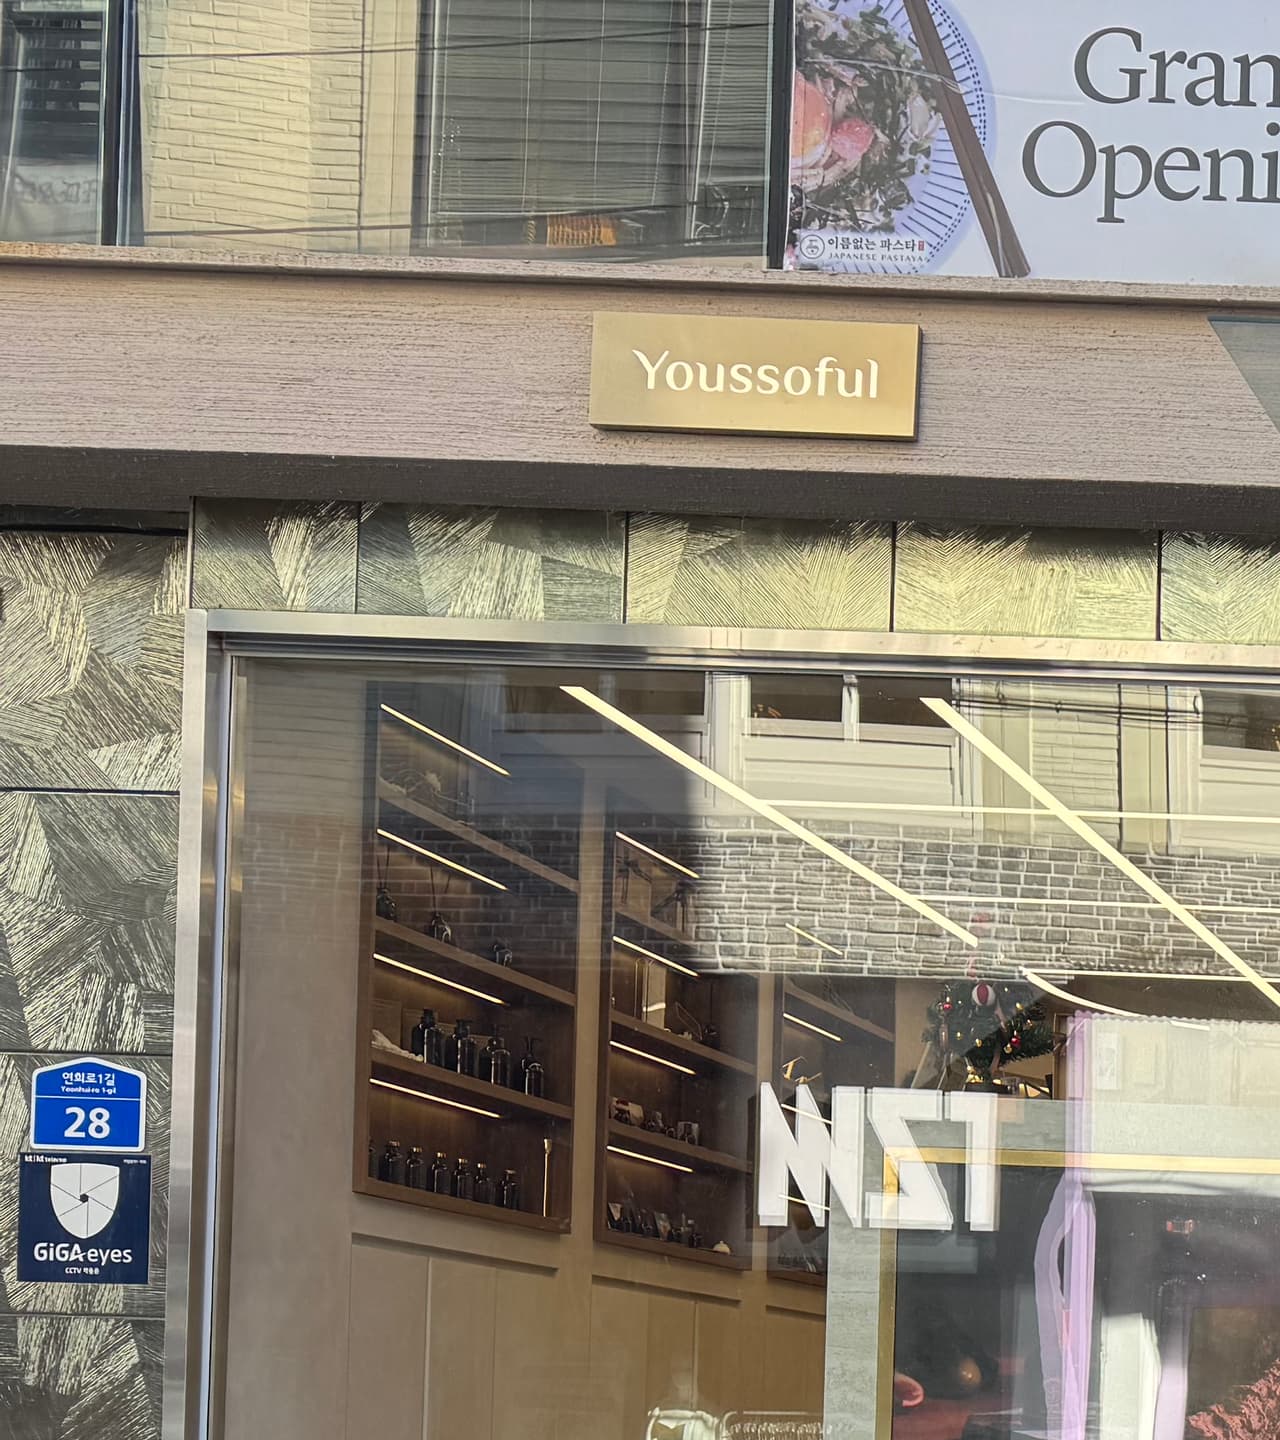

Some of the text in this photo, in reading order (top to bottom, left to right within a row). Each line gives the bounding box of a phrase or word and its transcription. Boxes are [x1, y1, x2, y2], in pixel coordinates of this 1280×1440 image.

[827, 236, 917, 252] 이름없는 파스타
[828, 253, 878, 262] JAPANESE
[632, 349, 880, 400] Youssoful
[63, 1106, 111, 1139] 28
